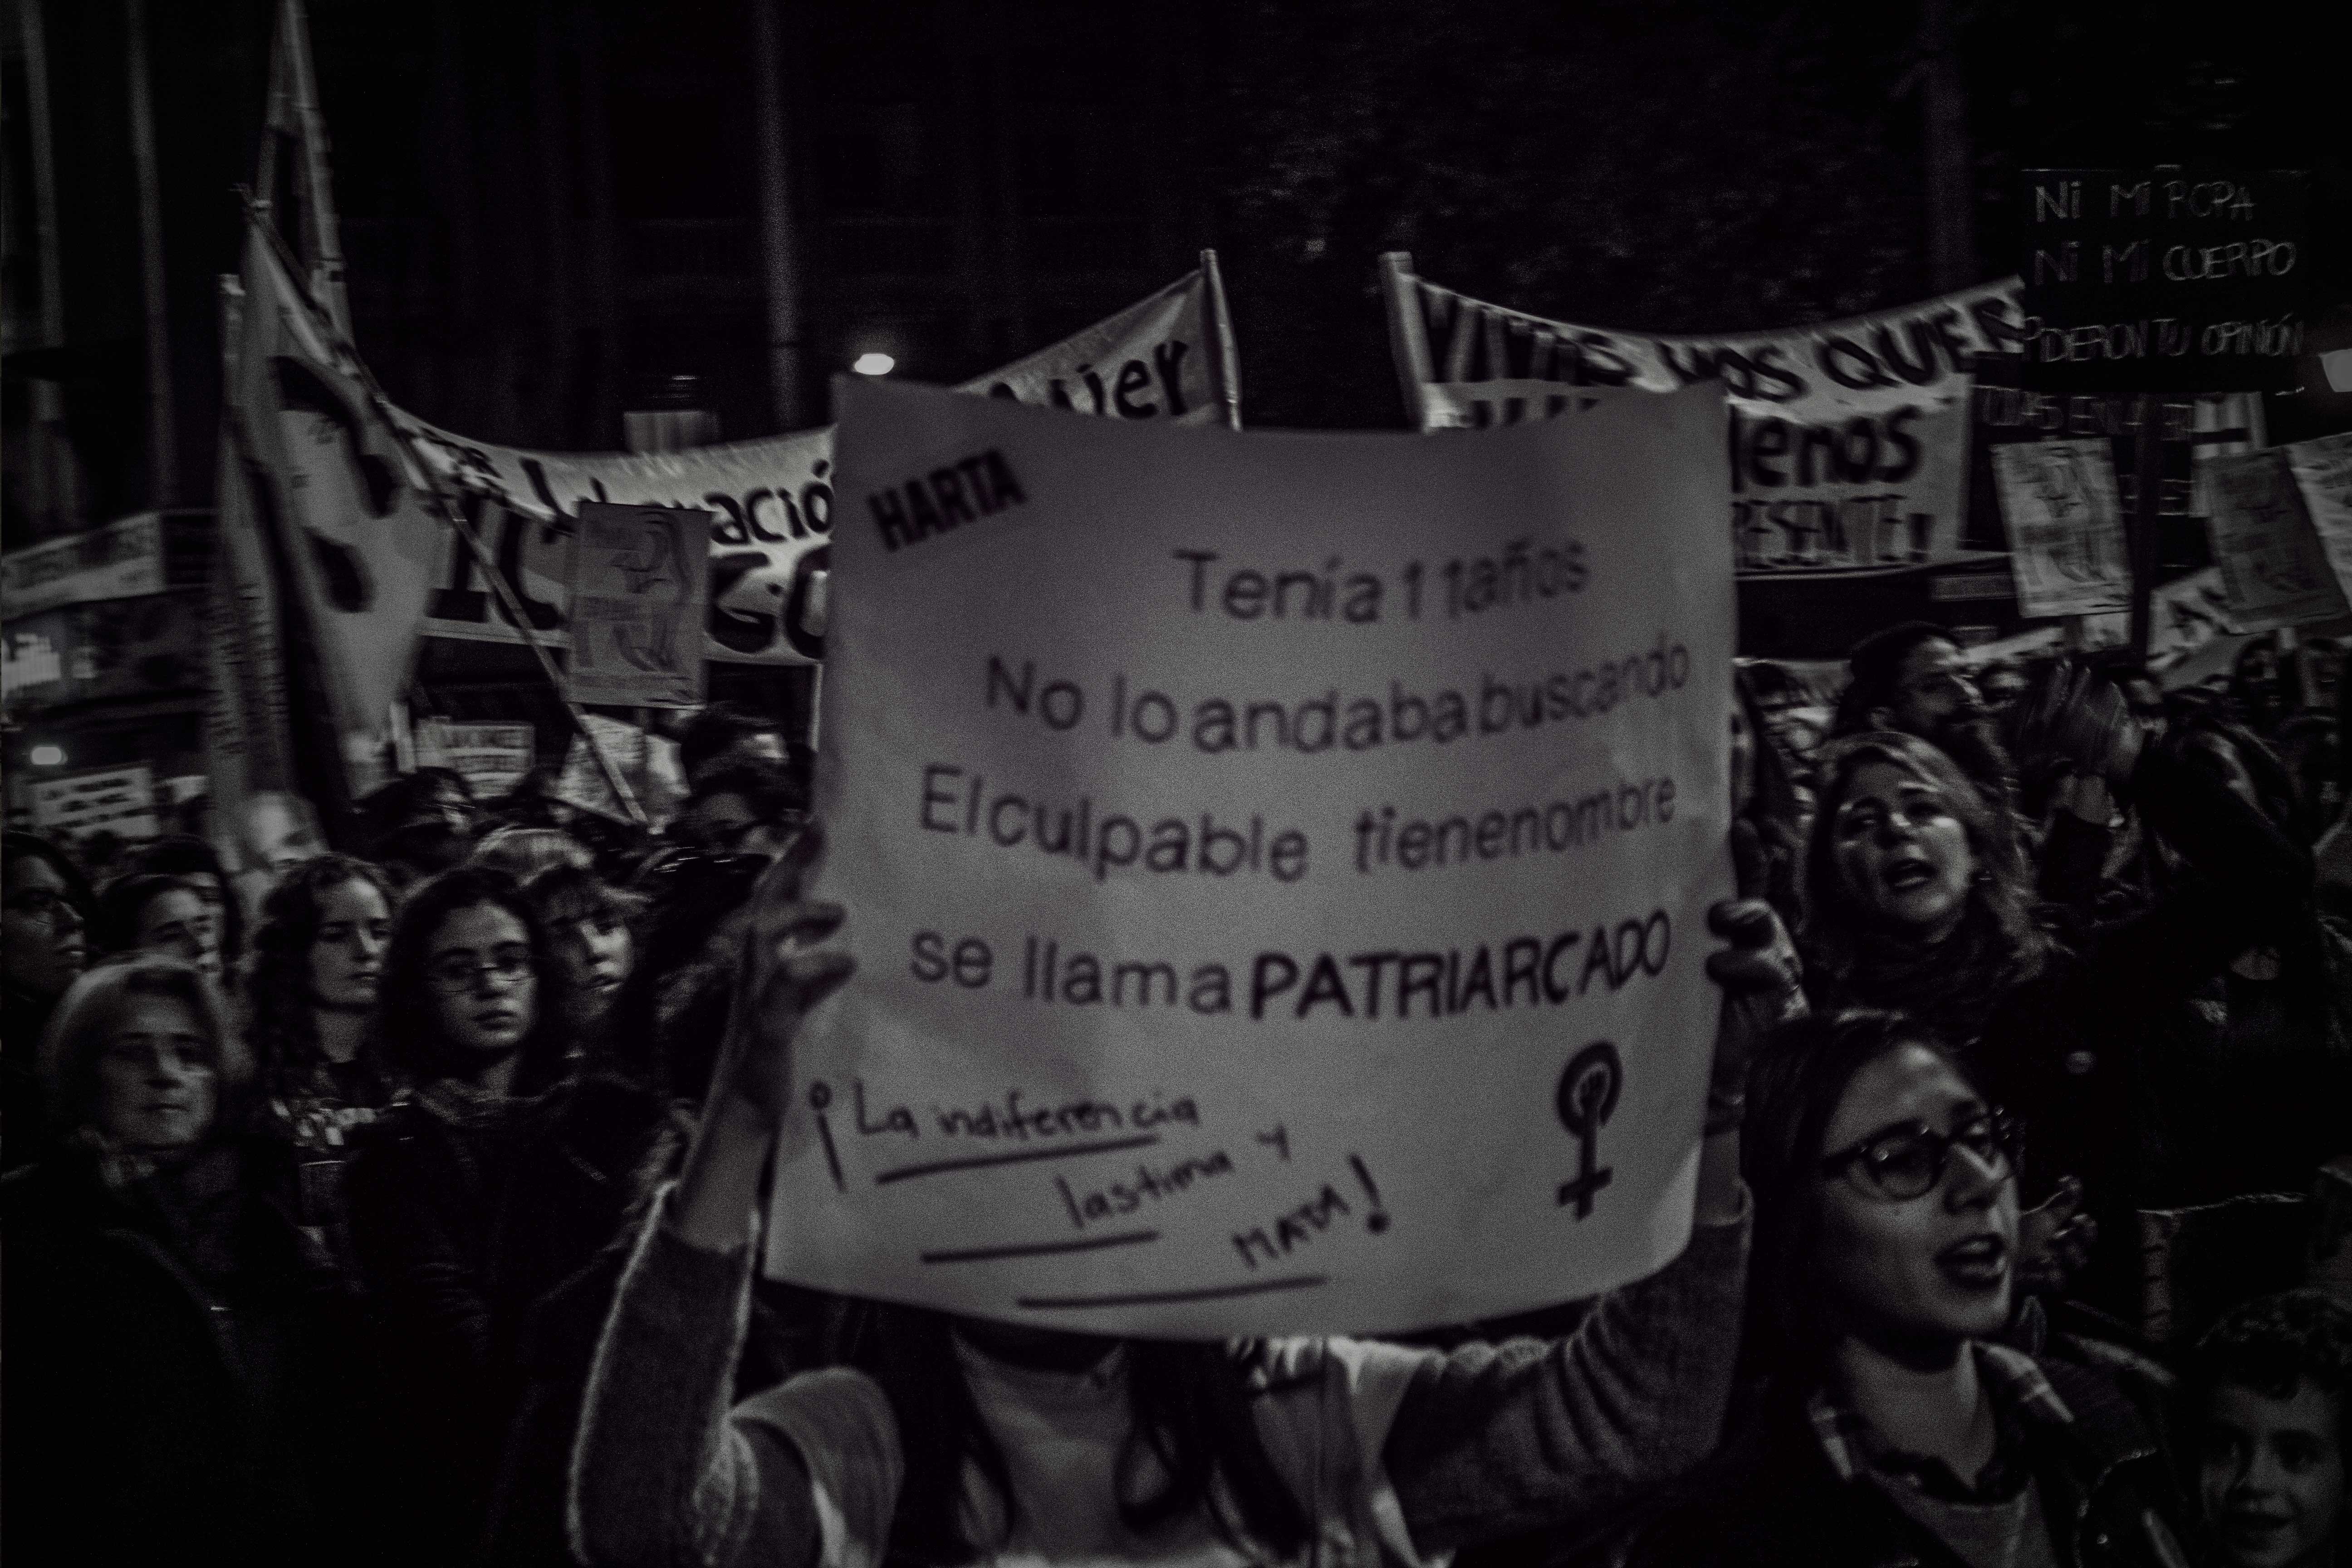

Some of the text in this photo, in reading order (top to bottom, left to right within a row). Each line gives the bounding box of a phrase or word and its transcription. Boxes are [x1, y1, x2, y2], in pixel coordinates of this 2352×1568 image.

[2162, 238, 2297, 282] CUERPO
[1729, 405, 1921, 493] enos
[867, 451, 1026, 551] HARTA
[1175, 550, 1382, 623] Tenía
[988, 632, 1690, 753] No lo andaba buscando
[921, 763, 1676, 882] El culpable tiene nombre
[911, 910, 1670, 1020] se llama PATRIARCADO
[932, 1089, 1200, 1140] indiferencia
[1057, 1151, 1233, 1230] lastima
